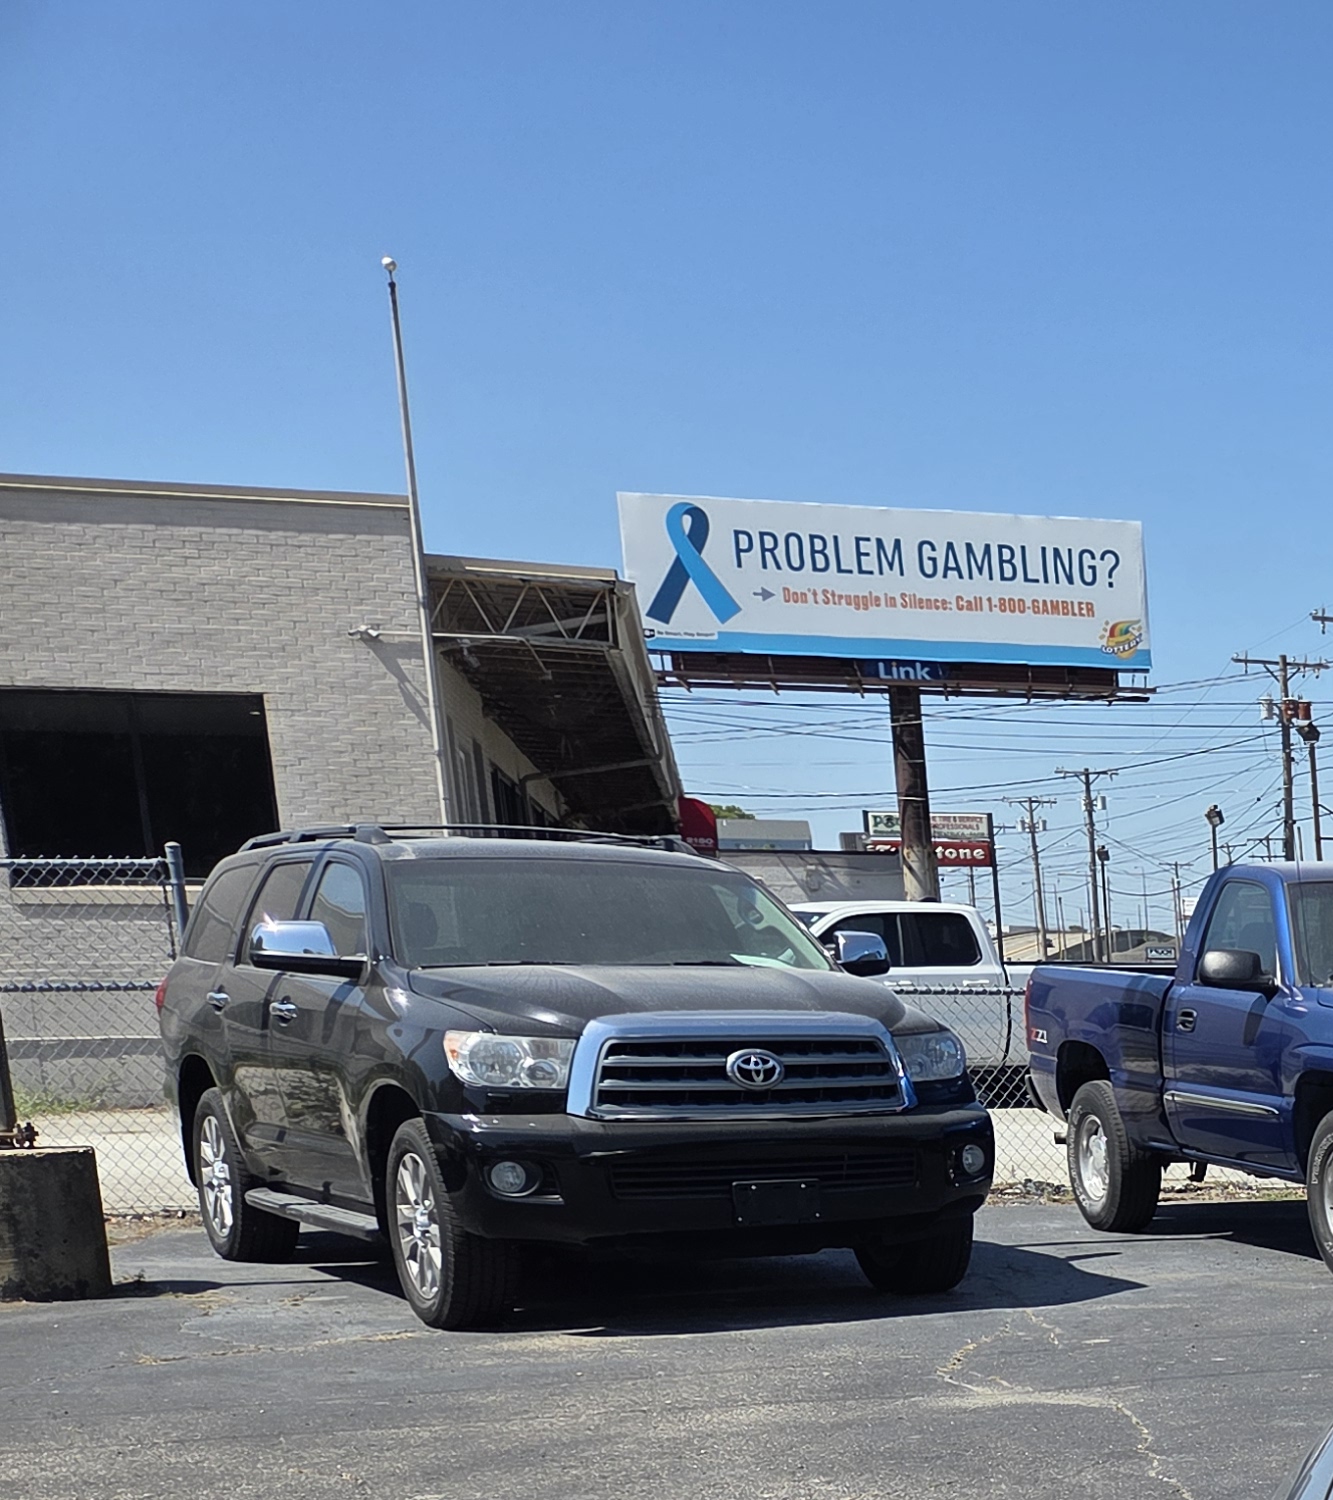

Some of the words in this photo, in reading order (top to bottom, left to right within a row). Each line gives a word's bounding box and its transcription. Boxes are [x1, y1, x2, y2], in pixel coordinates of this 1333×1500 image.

[733, 528, 905, 578] PROBLEM
[917, 539, 1121, 589] GAMBLING?
[782, 586, 819, 605] Don't
[822, 588, 881, 611] Struggle
[884, 592, 897, 609] in
[900, 592, 953, 611] Silence:
[955, 595, 984, 613] Call
[986, 596, 1095, 618] 1-800-GAMBLER
[877, 661, 932, 681] Link
[1031, 1027, 1048, 1043] Z71
